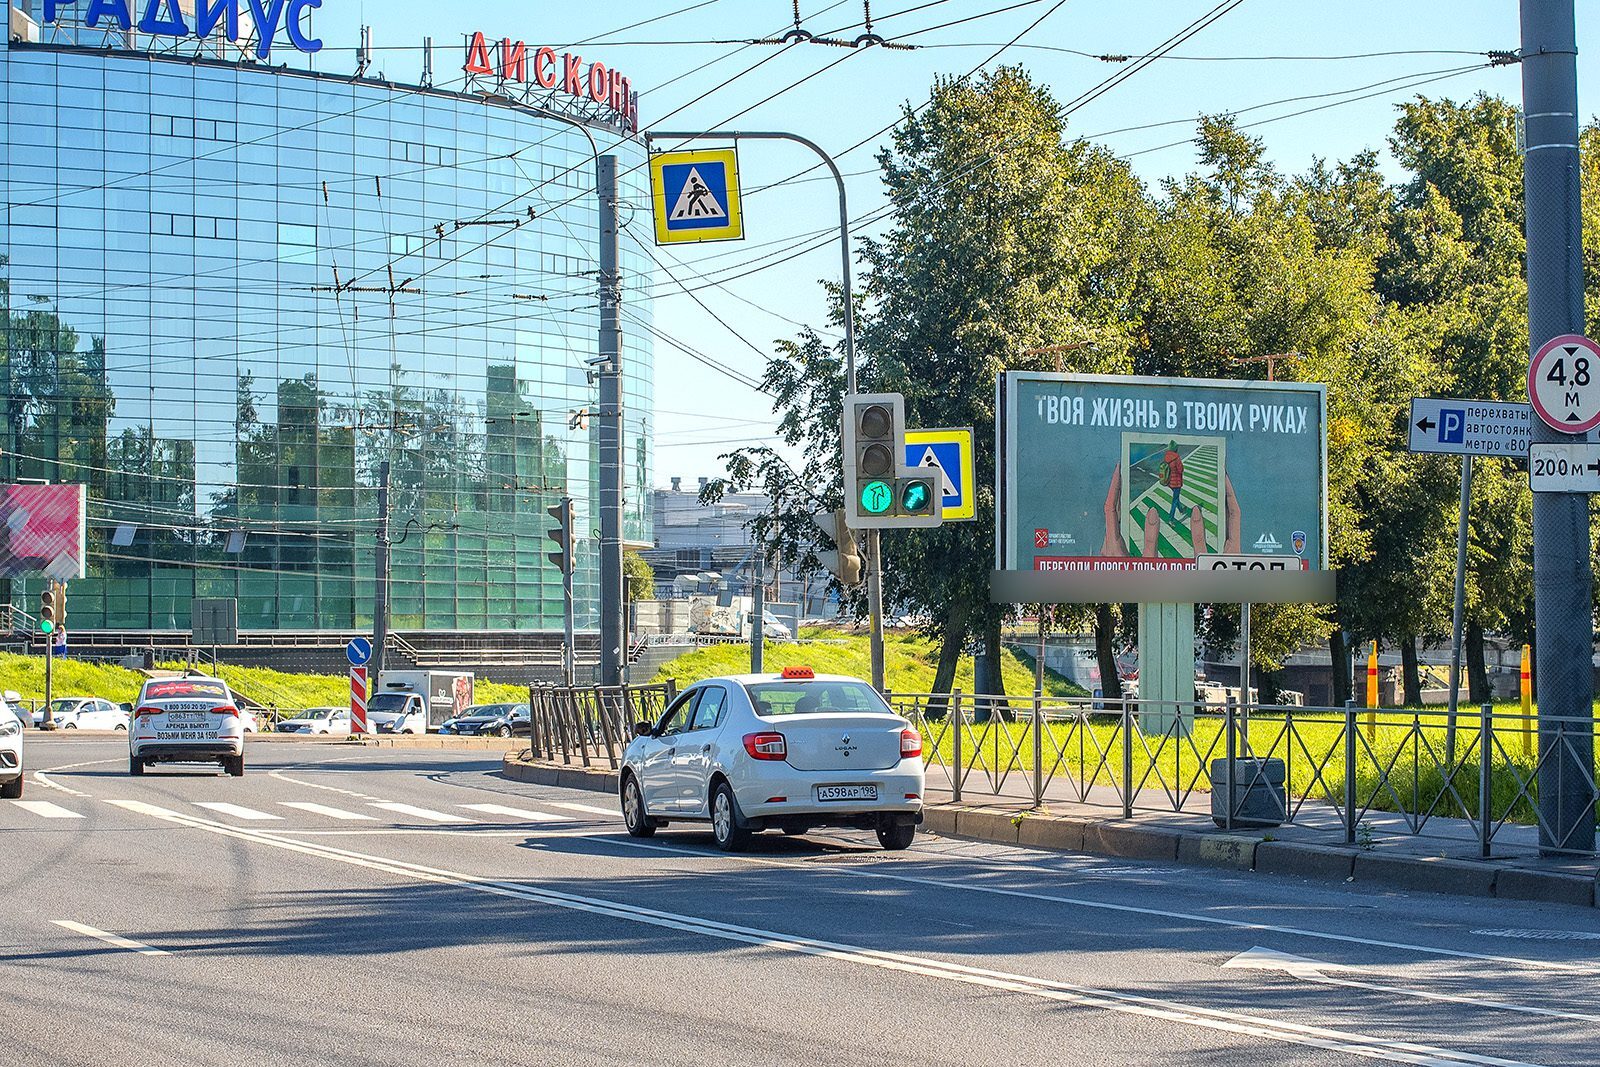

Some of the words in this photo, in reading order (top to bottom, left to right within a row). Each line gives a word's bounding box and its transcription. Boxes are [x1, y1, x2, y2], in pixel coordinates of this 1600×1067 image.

[1546, 357, 1591, 390] 4,8
[1035, 395, 1084, 425] ТВОЯ
[1090, 397, 1160, 428] ЖИЗНЬ
[1165, 400, 1178, 429] В
[1183, 401, 1243, 432] ТВОИХ
[1249, 404, 1308, 434] РУКАХ
[1465, 439, 1500, 452] метро
[1534, 459, 1568, 476] 200
[157, 731, 180, 740] ВОЗЬМИ
[180, 731, 196, 739] МЕНЯ
[197, 731, 204, 739] ЗА
[205, 731, 218, 739] 1500
